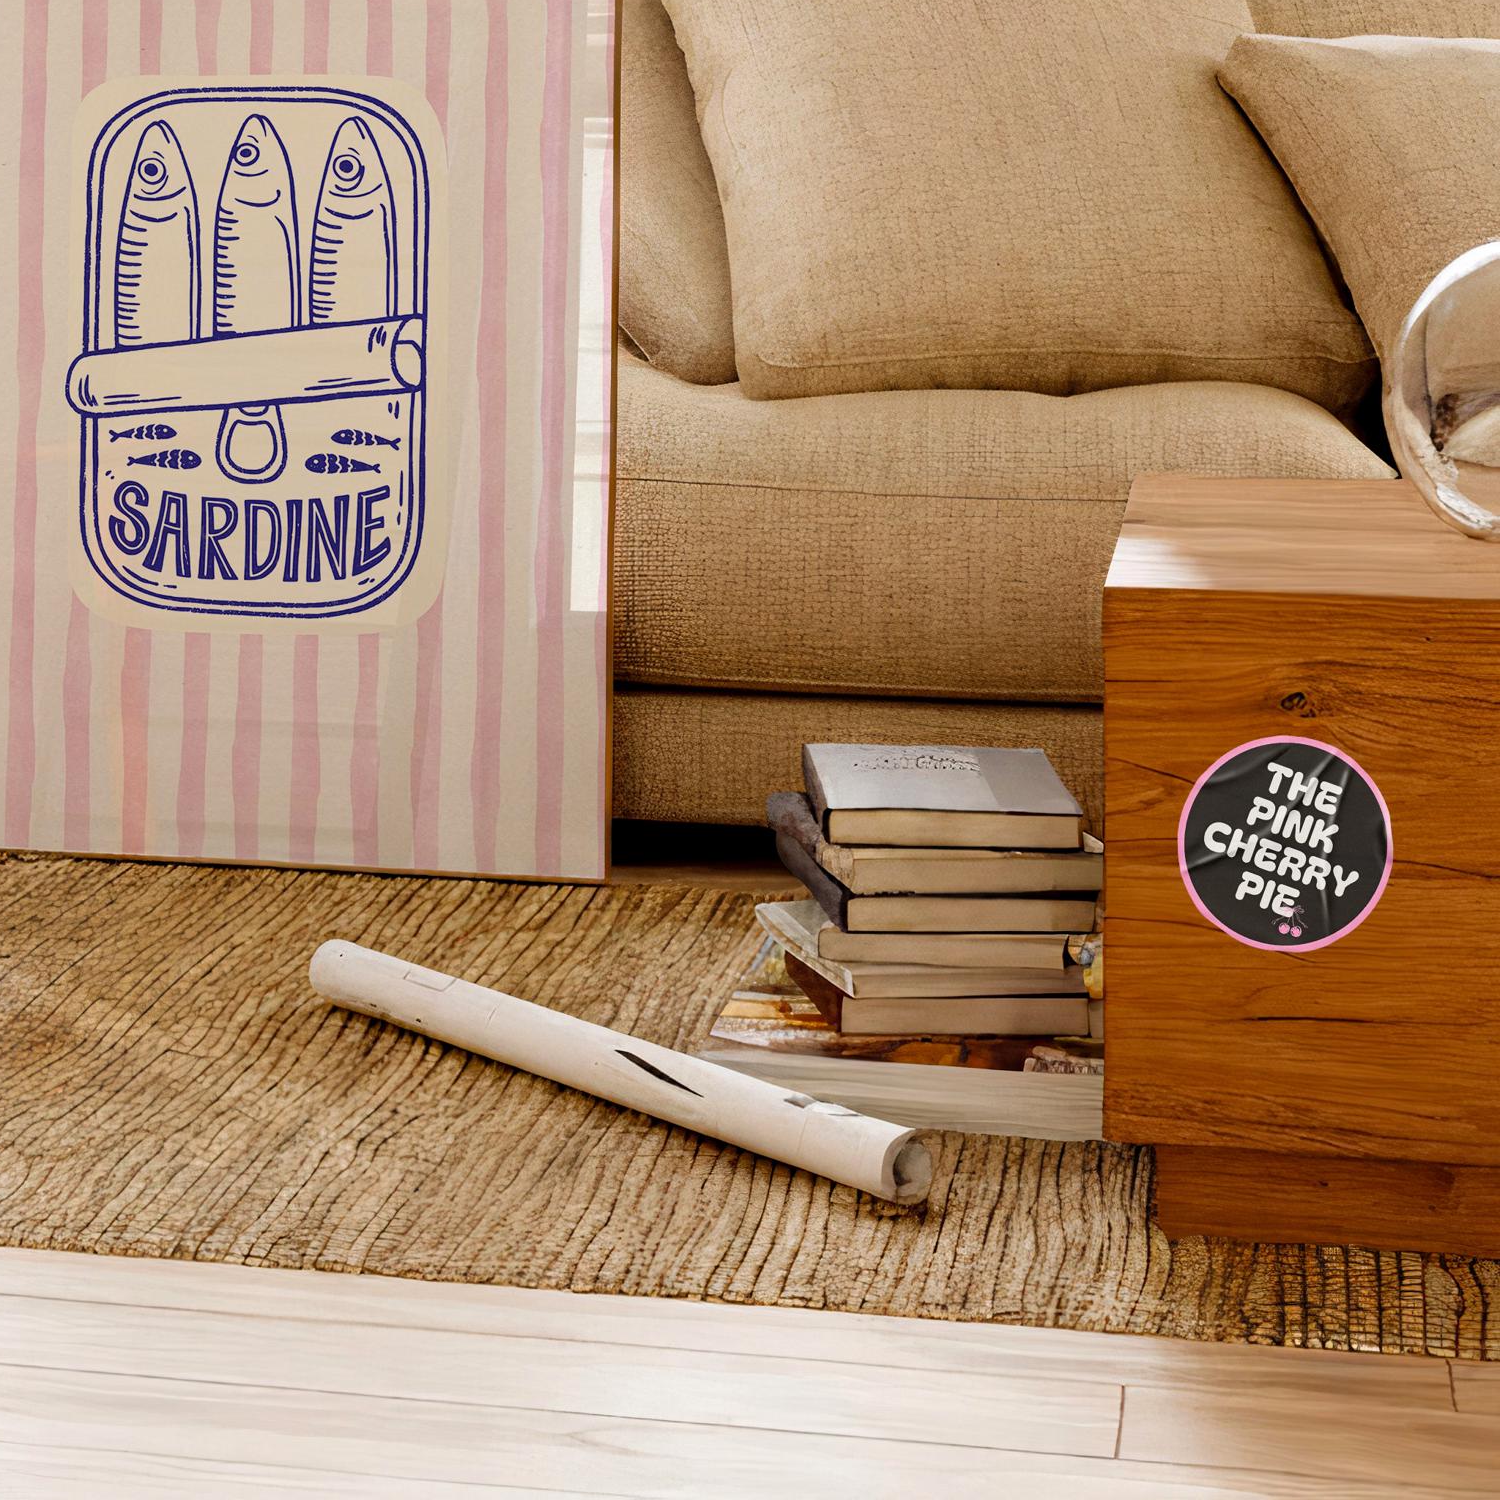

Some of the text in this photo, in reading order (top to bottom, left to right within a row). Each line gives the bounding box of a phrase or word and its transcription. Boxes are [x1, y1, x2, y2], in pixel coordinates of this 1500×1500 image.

[109, 480, 390, 583] SARDINE
[1267, 761, 1343, 815] THE
[1246, 796, 1339, 854] PINK
[1203, 821, 1359, 897] CHERRY
[1235, 871, 1300, 918] PIE
